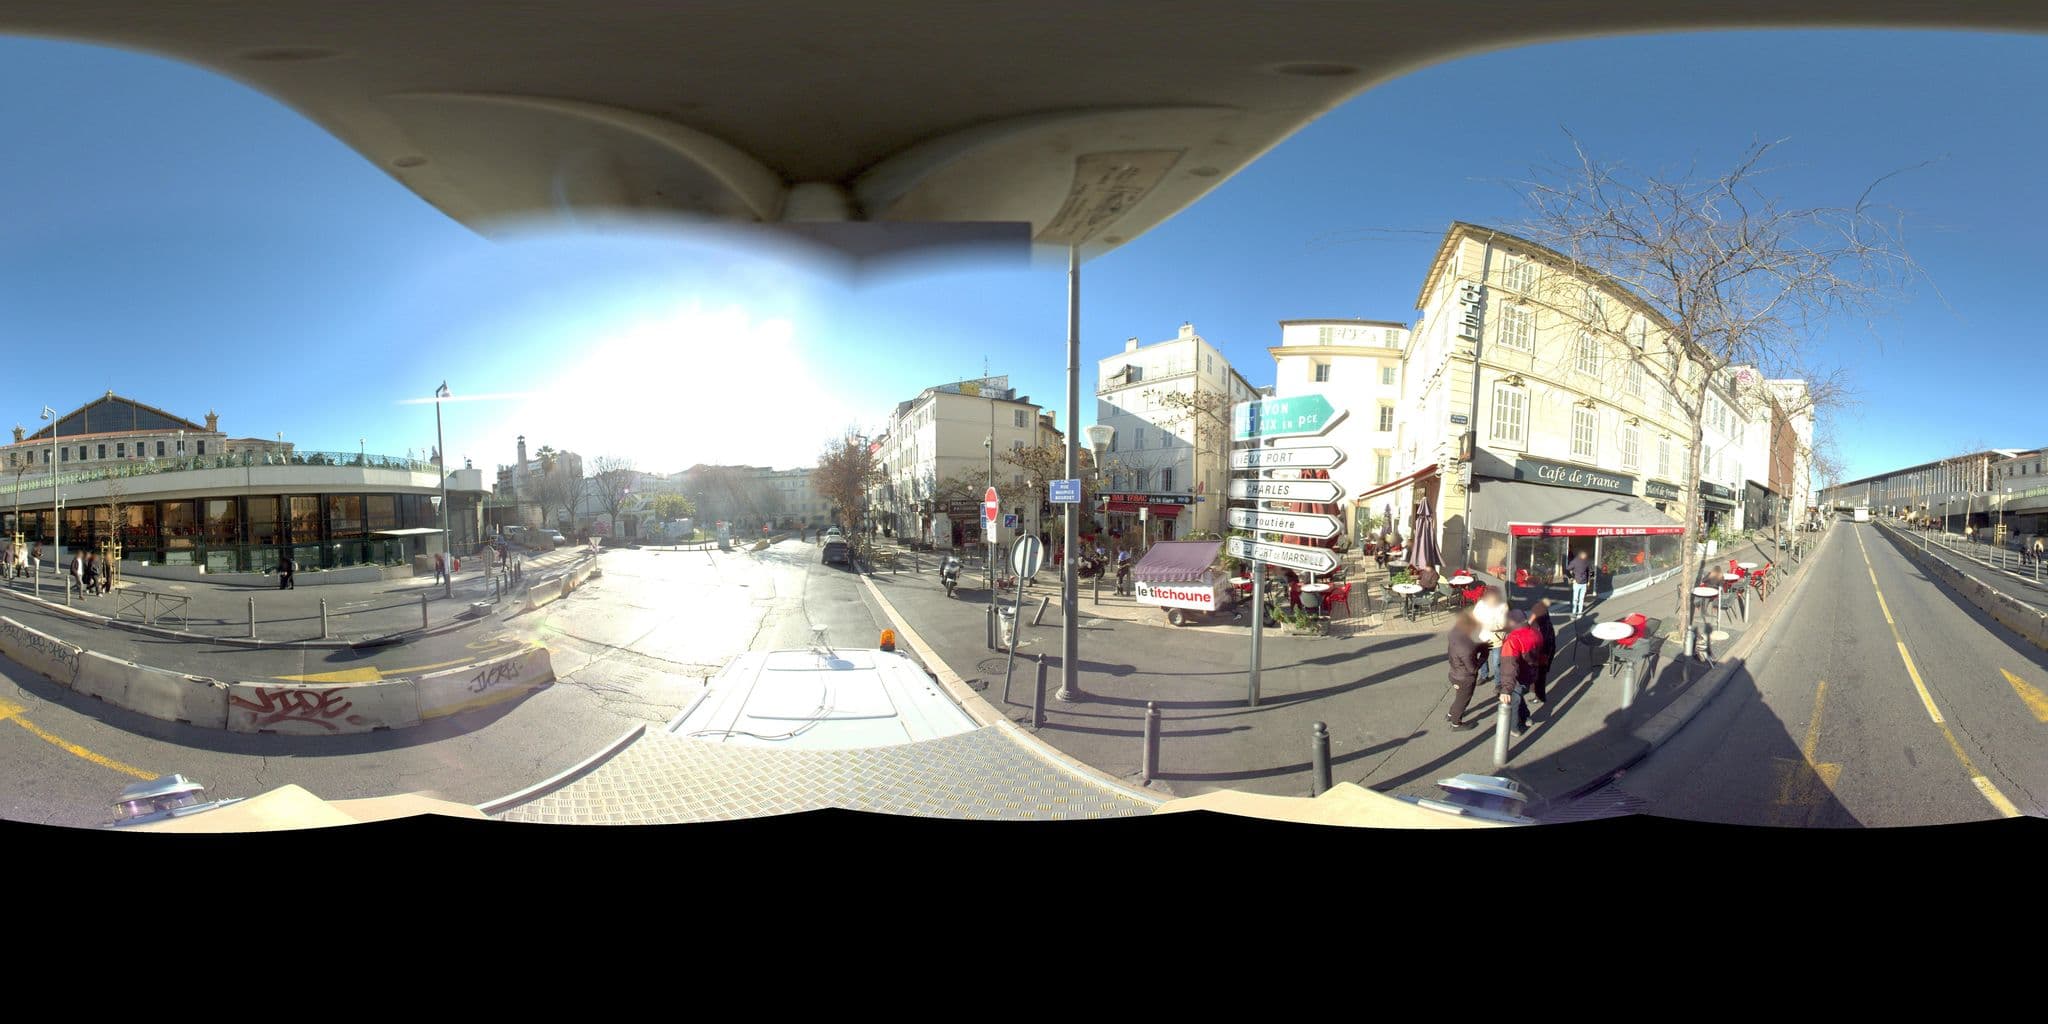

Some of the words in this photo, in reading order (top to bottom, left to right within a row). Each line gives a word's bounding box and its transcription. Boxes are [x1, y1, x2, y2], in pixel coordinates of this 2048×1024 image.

[1457, 280, 1481, 340] HOTEL
[1259, 419, 1277, 431] AIX
[1265, 453, 1294, 463] PORT
[1538, 465, 1567, 483] Café
[1568, 469, 1583, 483] de
[1583, 473, 1620, 489] France
[1246, 485, 1290, 495] CHARLES
[1138, 585, 1148, 597] le
[1149, 586, 1211, 602] titchoune
